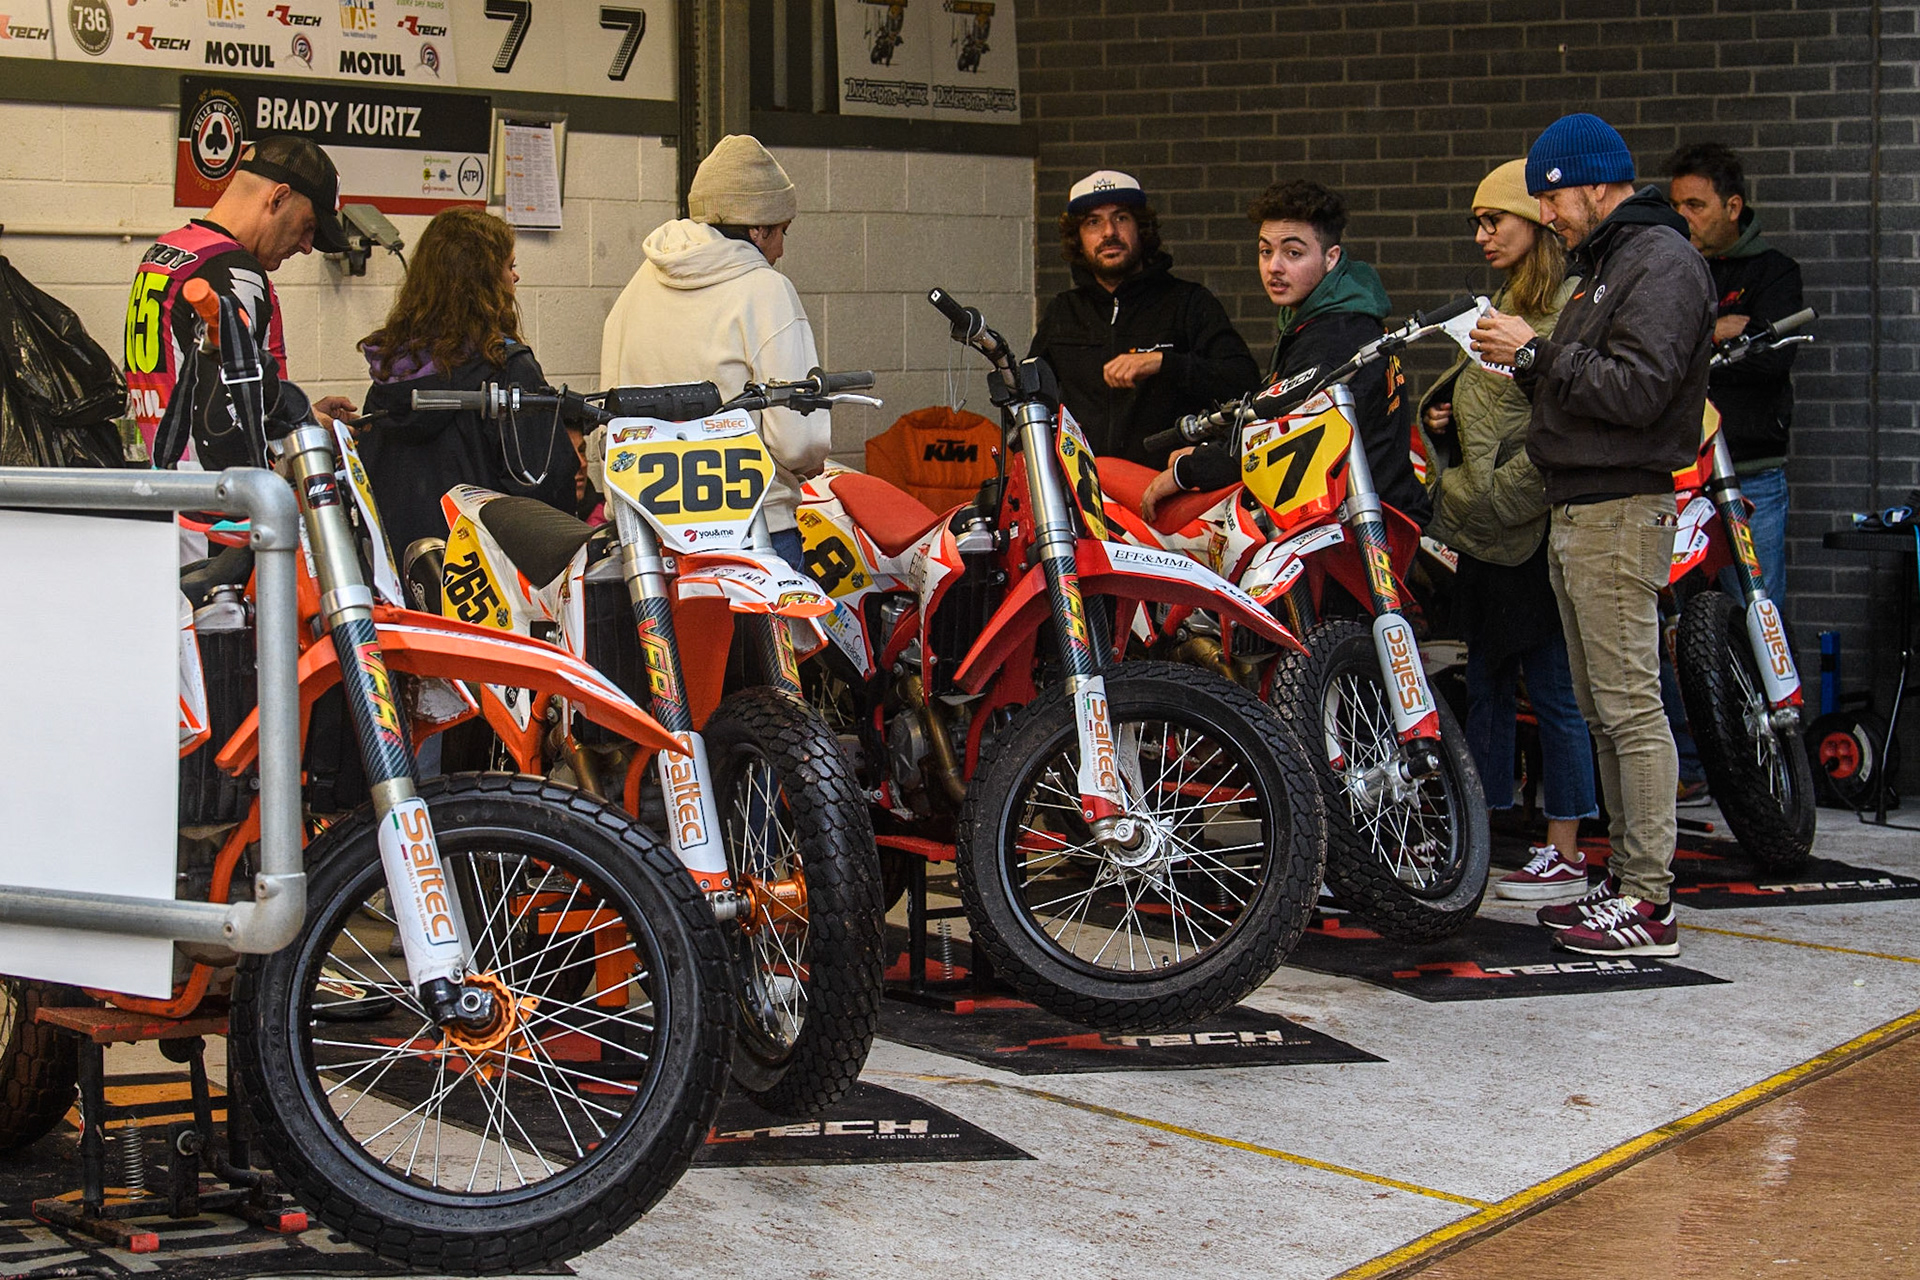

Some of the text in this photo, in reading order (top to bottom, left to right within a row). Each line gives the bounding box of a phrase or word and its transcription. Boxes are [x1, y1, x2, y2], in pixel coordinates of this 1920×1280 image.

[74, 6, 107, 31] 736
[484, 0, 532, 73] 7
[599, 5, 646, 81] 7
[205, 41, 275, 68] MOTUL
[339, 50, 405, 77] MOTUL
[227, 110, 241, 134] ACES
[256, 96, 422, 138] BRADY KURTZ
[704, 418, 746, 430] Saltec
[923, 439, 978, 462] KTM
[638, 448, 764, 516] 265
[1267, 424, 1326, 509] 7
[442, 551, 500, 624] 265
[803, 536, 855, 596] 8
[1113, 549, 1195, 570] EFF&MME
[1386, 628, 1423, 710] Saltec
[1759, 602, 1792, 676] Saltec
[1092, 698, 1118, 788] Saltec
[666, 779, 682, 840] QUALITY WELDING
[667, 733, 703, 844] Saltec
[400, 807, 455, 938] Saltec
[404, 861, 431, 932] QUALITY WELDING
